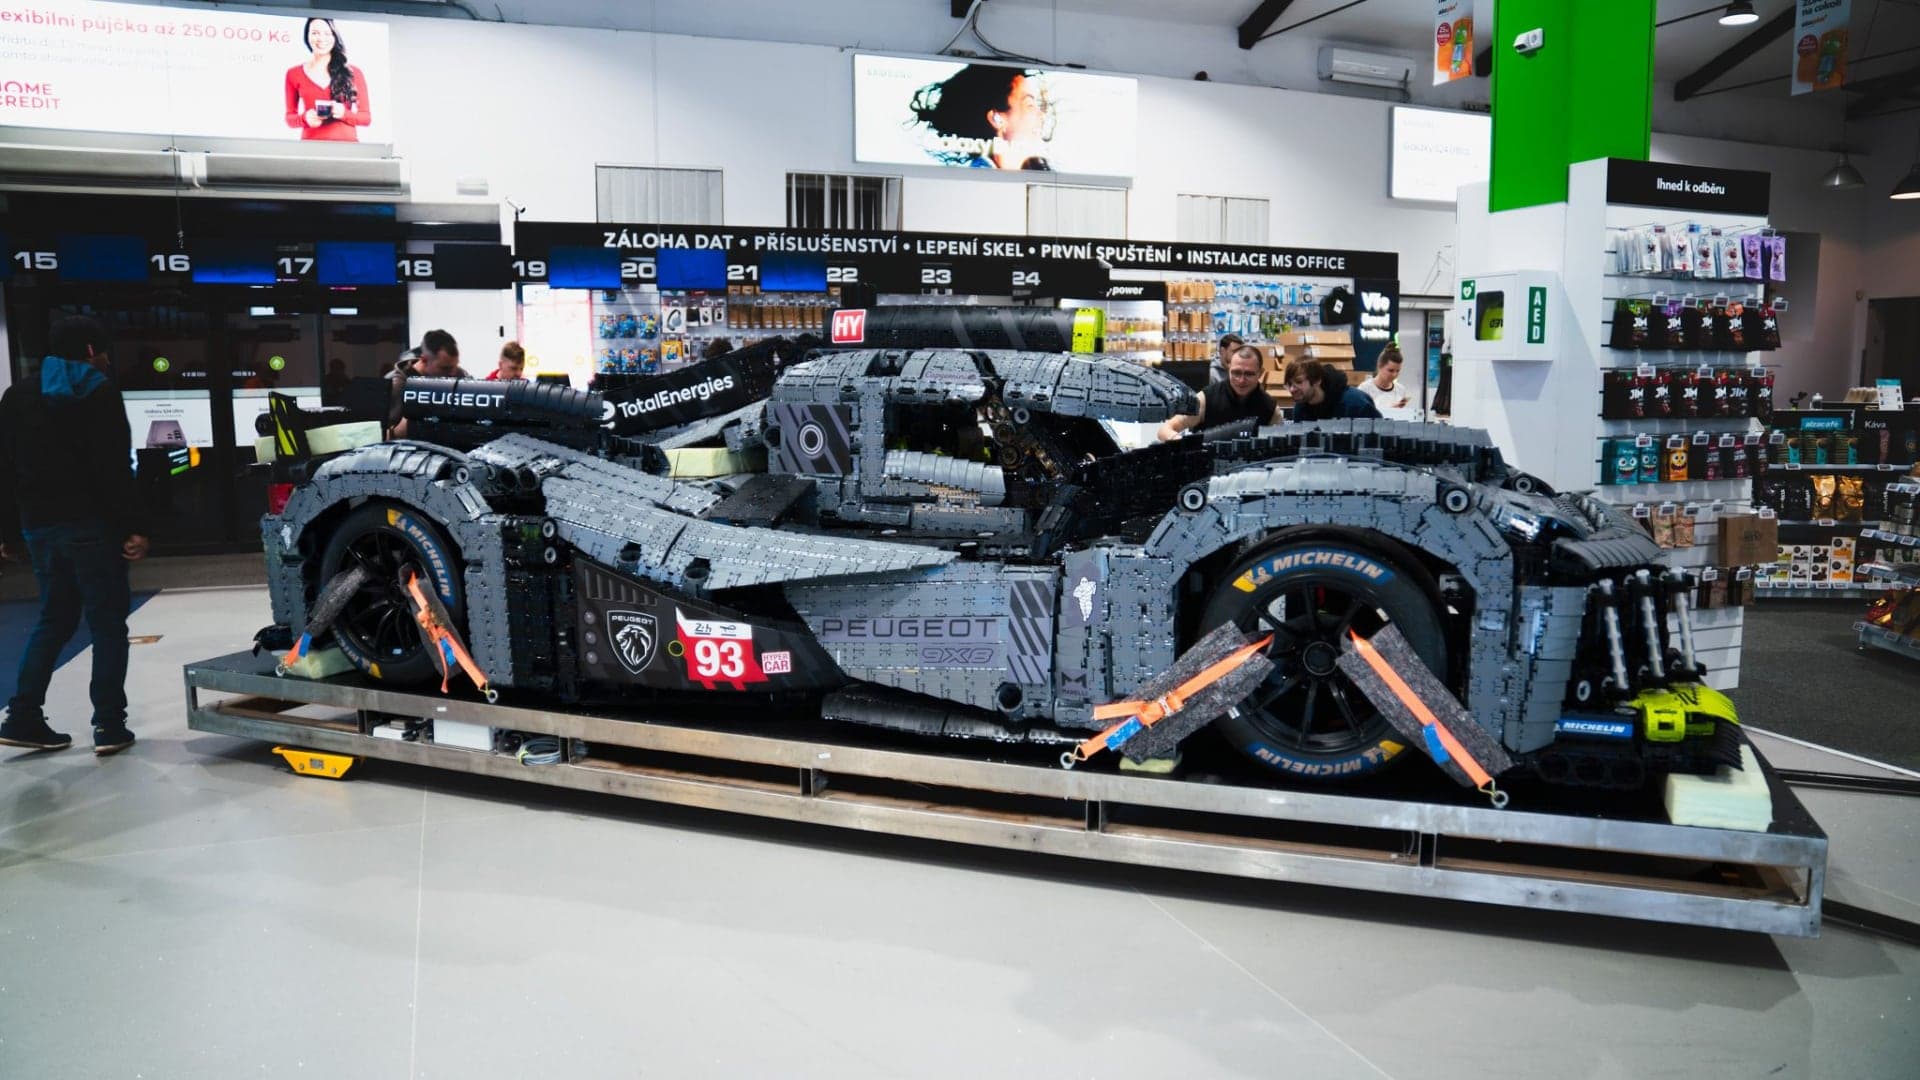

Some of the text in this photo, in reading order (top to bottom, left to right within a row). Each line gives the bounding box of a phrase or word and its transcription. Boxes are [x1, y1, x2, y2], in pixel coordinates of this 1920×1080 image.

[154, 23, 177, 36] až
[182, 25, 217, 39] 250
[223, 26, 262, 41] 000
[269, 29, 291, 43] Kč
[1657, 177, 1725, 195] Ihned k odběru
[603, 229, 1346, 270] ZÁLOHA DAT PŘÍSLUŠENSTVÍ LEPENÍ SKEL PRVNÍ SPUŠTĚNÍ INSTALACE MS OFFICE
[14, 251, 58, 270] 15
[151, 254, 190, 272] 16
[277, 257, 314, 275] 17
[397, 260, 433, 277] 18
[512, 260, 547, 277] 19
[621, 262, 657, 279] 20
[726, 264, 759, 281] 21
[826, 267, 858, 283] 22
[921, 269, 952, 284] 23
[1012, 271, 1041, 286] 24
[1532, 290, 1542, 340] AED
[834, 315, 862, 338] HY
[403, 390, 505, 408] PEUGEOT
[617, 374, 733, 420] TotalEnergies
[1864, 419, 1887, 430] Káva
[408, 526, 451, 597] MICHELIN
[1272, 550, 1385, 579] MICHELIN
[611, 615, 654, 625] PEUGEOT
[822, 618, 997, 637] PEUGEOT
[694, 640, 745, 677] 93
[763, 654, 788, 662] HYPER
[922, 647, 995, 664] 9X8
[764, 660, 789, 672] CAR
[1563, 721, 1625, 733] MICHELIN
[1255, 747, 1362, 776] MICHELIN
